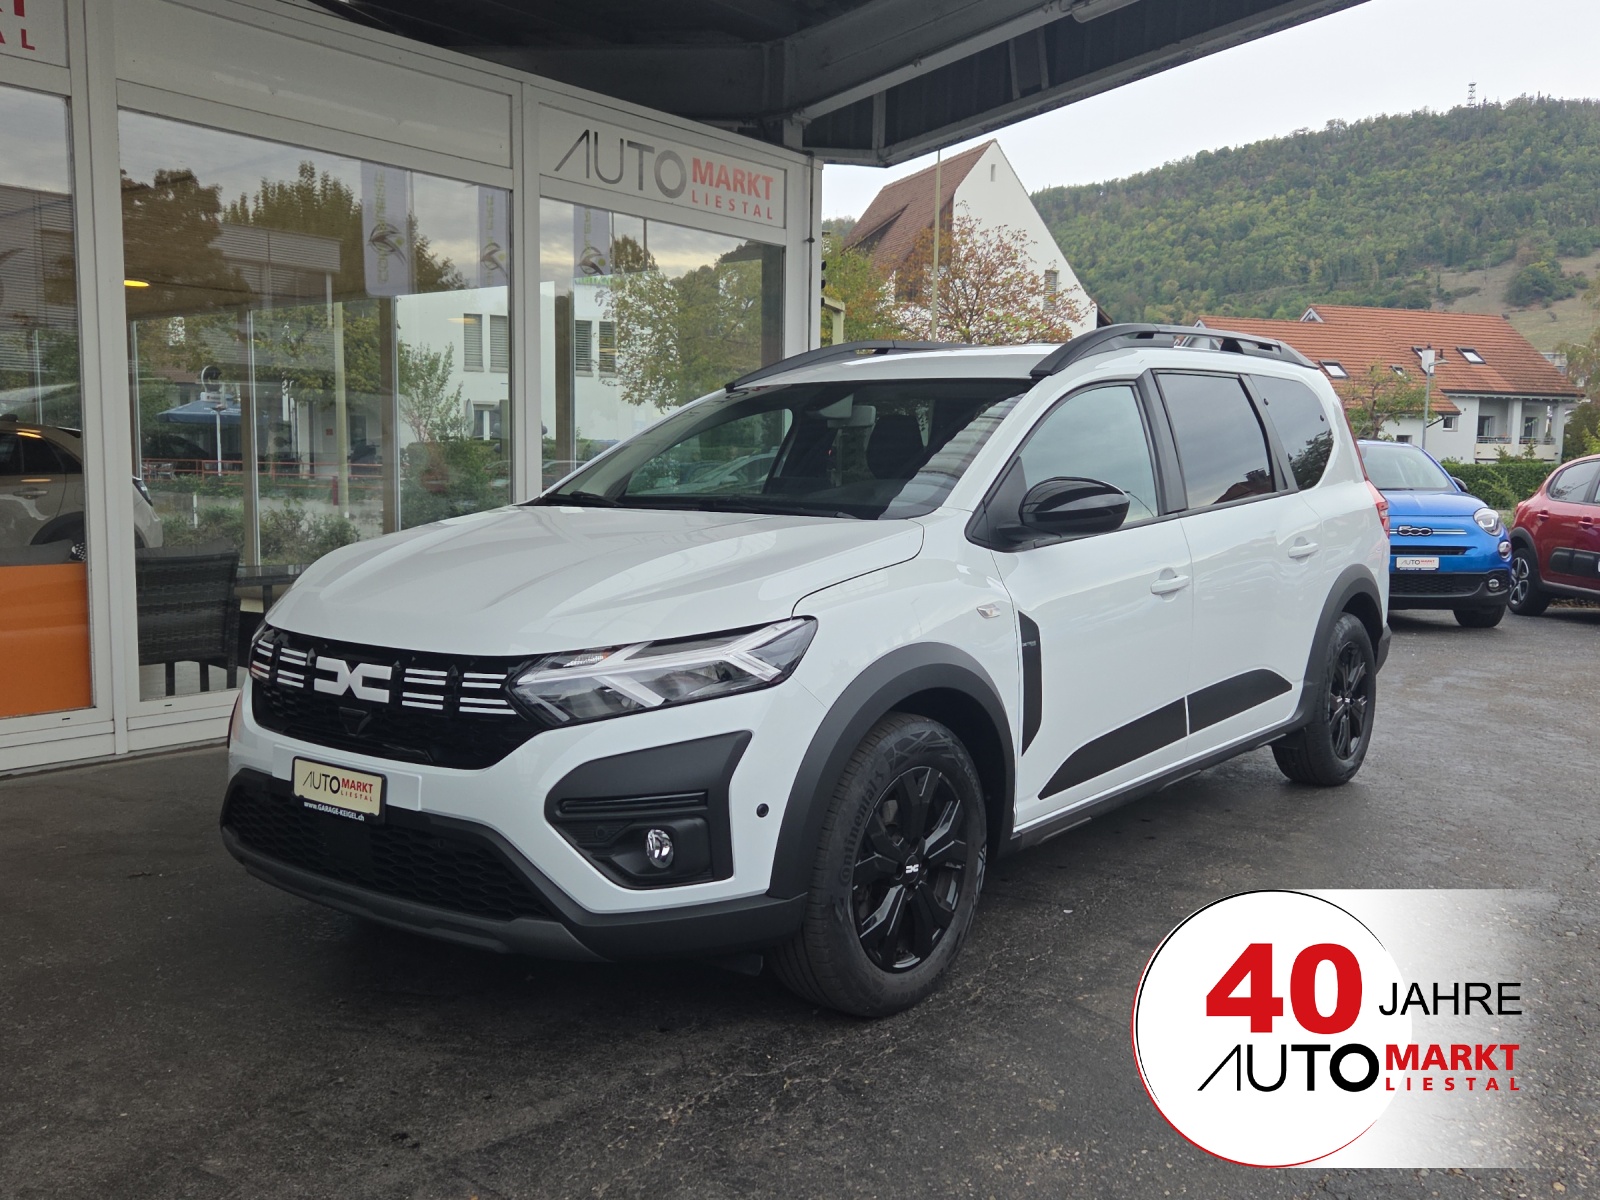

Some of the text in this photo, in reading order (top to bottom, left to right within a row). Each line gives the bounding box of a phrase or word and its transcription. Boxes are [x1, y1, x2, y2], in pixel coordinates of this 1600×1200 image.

[554, 129, 774, 200] AUTO MARKT
[692, 190, 773, 220] LIESTAL
[1397, 525, 1433, 536] 500
[303, 771, 373, 794] AUTO MARKT
[341, 790, 373, 802] LIESTAL
